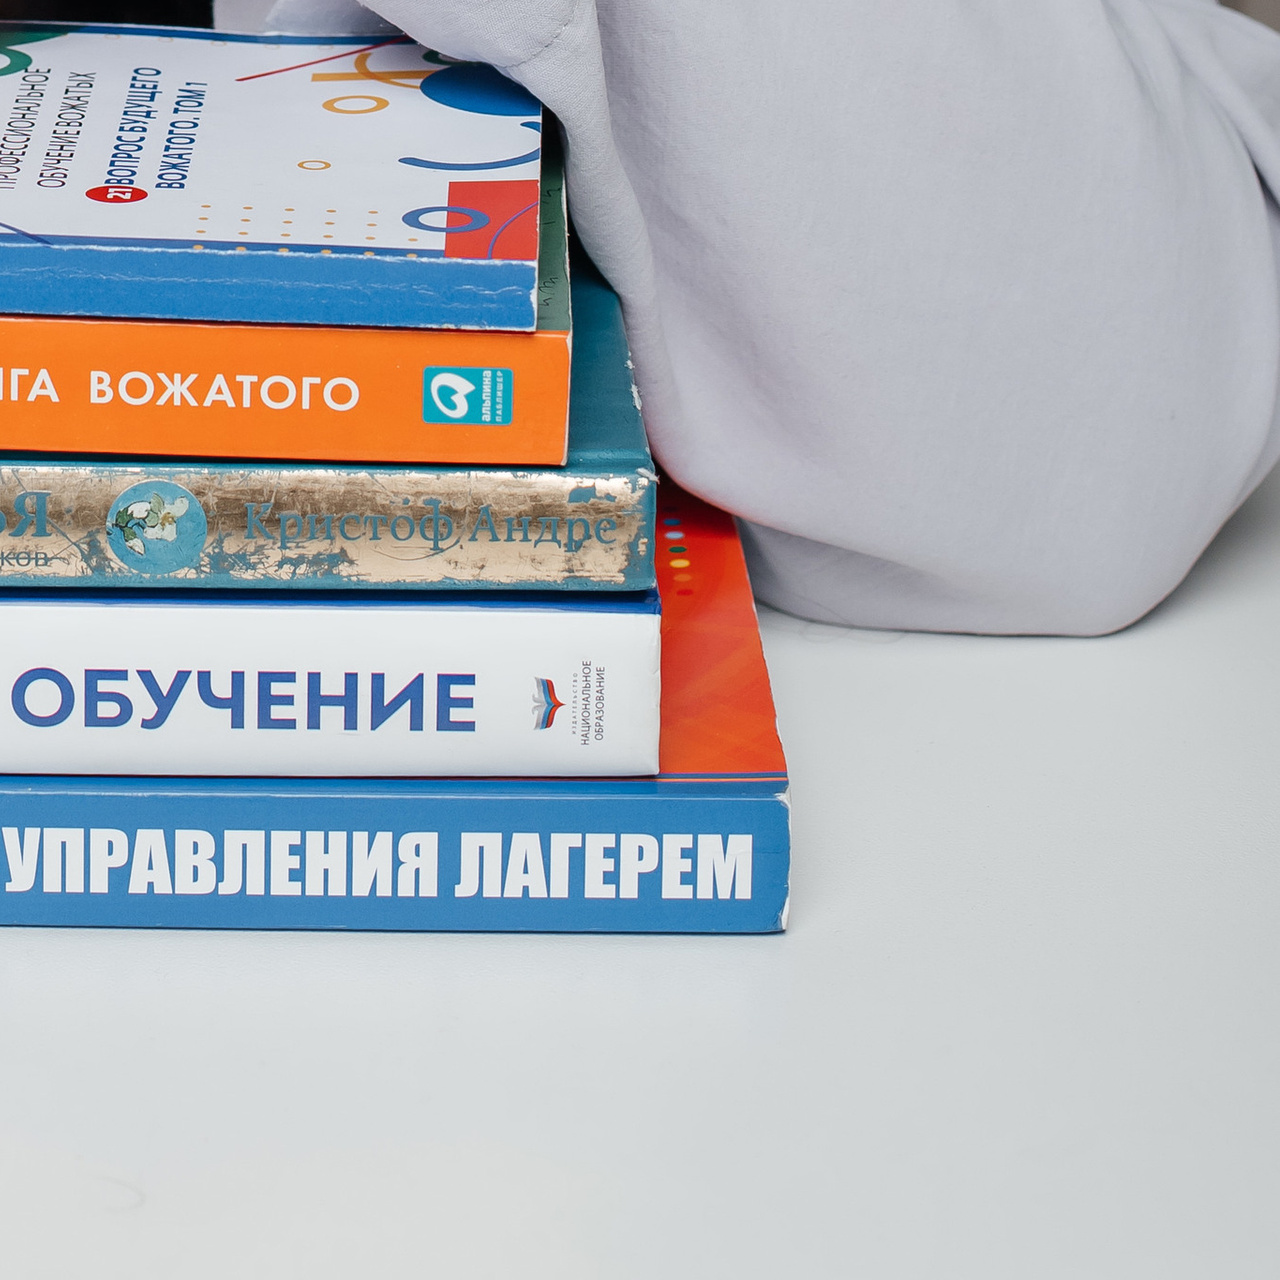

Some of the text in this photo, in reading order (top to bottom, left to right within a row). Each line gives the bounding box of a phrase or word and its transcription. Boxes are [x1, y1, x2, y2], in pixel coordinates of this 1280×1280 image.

[37, 71, 97, 189] ОБУЧЕНИЕ ВОЖАТЫХ
[104, 67, 163, 200] 21 ВОПРОС БУДУЩЕГО
[173, 88, 207, 114] ТОМ
[155, 117, 200, 190] ВОЖАТОГО.
[90, 370, 360, 412] ВОЖАТОГО
[481, 369, 492, 422] альпина
[244, 497, 618, 553] Кристоф Андре
[10, 666, 477, 732] ОБУЧЕНИЕ
[580, 660, 592, 746] НАЦИОНАЛЬНОЕ
[594, 666, 605, 741] ОБРАЗОВАНИЕ
[1, 826, 440, 898] УПРАВЛЕНИЯ
[453, 833, 754, 901] ЛАГЕРЕМ
